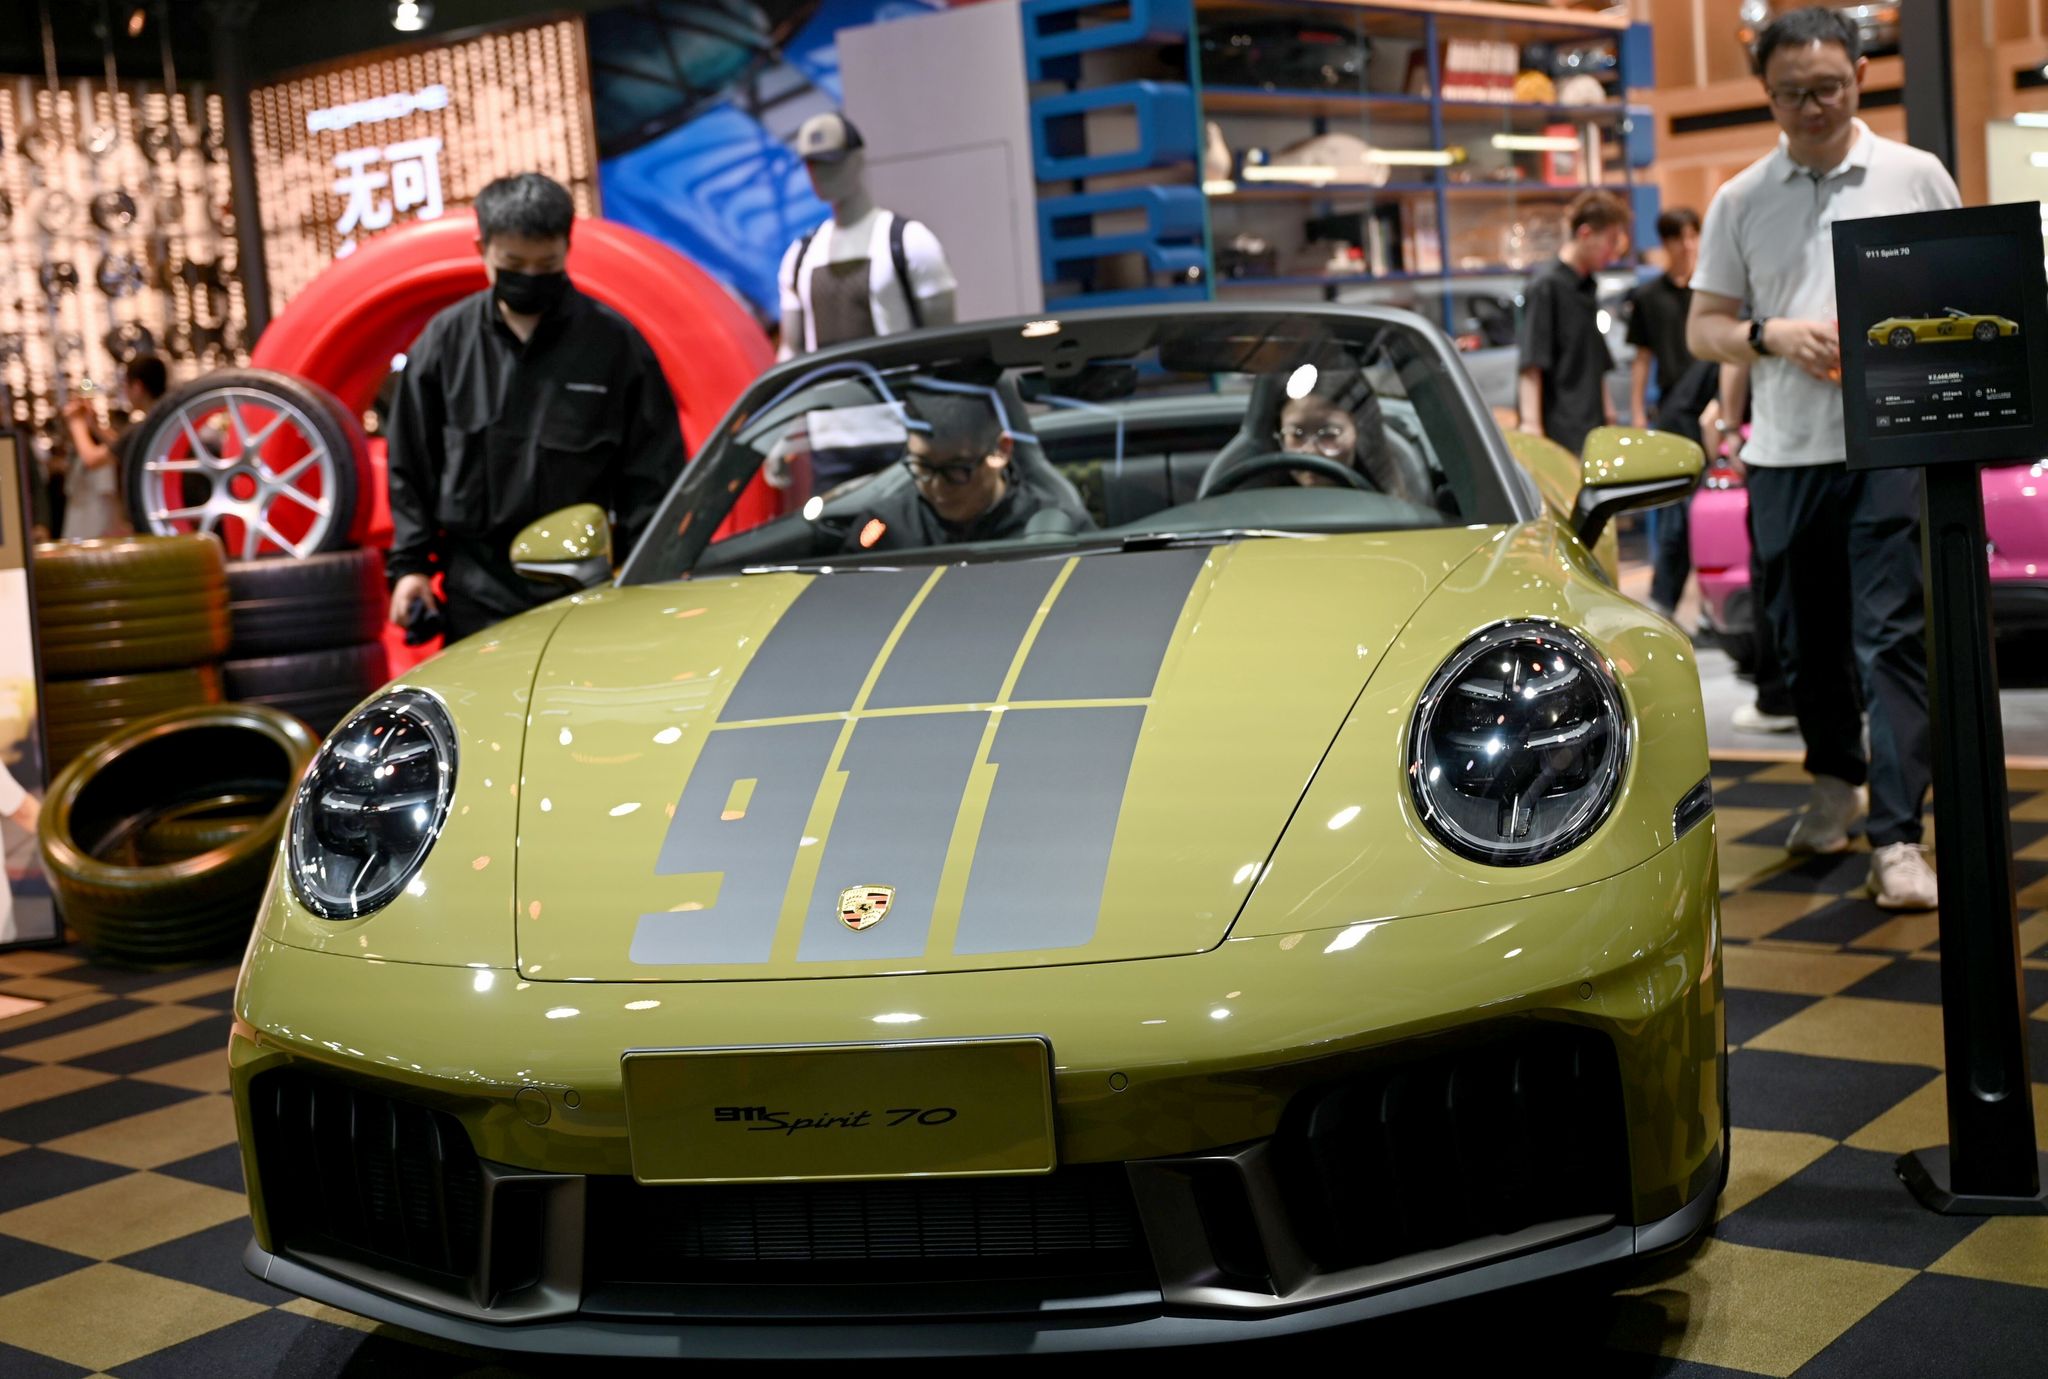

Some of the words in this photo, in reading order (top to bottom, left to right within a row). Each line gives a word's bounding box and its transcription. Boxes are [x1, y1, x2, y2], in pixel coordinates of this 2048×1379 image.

[331, 136, 444, 235] 无可
[1865, 250, 1879, 258] 911
[1880, 248, 1899, 259] Spirit
[1900, 246, 1910, 256] 70
[629, 704, 1148, 965] 911
[747, 1110, 871, 1136] Spirit
[886, 1107, 957, 1127] 70
